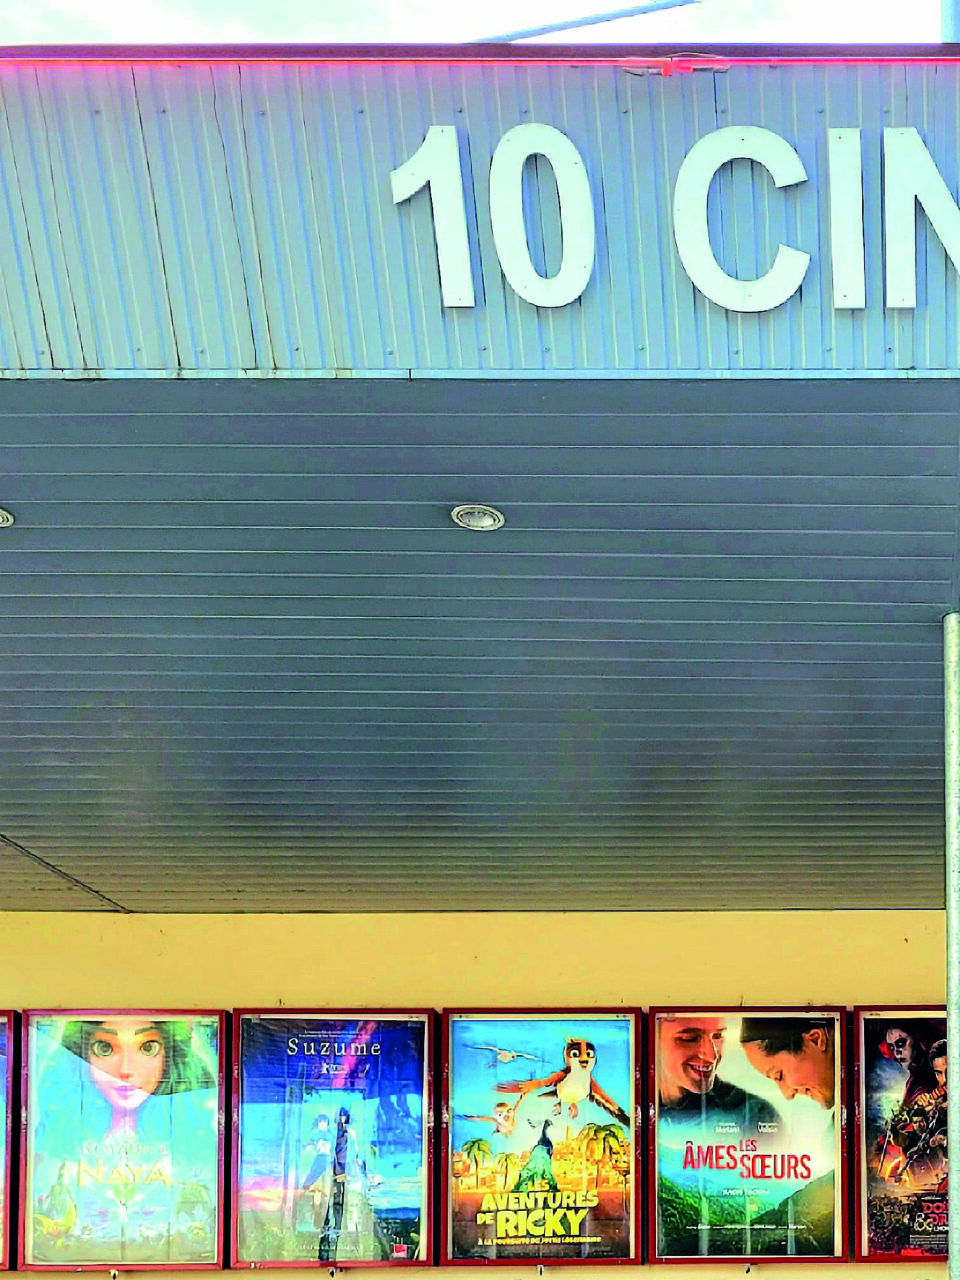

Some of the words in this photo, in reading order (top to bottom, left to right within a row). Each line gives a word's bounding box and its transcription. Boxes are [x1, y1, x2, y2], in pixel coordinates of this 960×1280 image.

[390, 123, 596, 309] 10
[287, 1037, 381, 1056] Suzume
[739, 1139, 758, 1152] LES
[683, 1140, 738, 1170] ÂMES
[739, 1154, 812, 1180] SŒURS
[77, 1159, 173, 1187] NAYA
[527, 1180, 550, 1191] LES
[481, 1189, 600, 1211] AVENTURES
[476, 1212, 495, 1225] DE
[496, 1208, 589, 1238] RICKY
